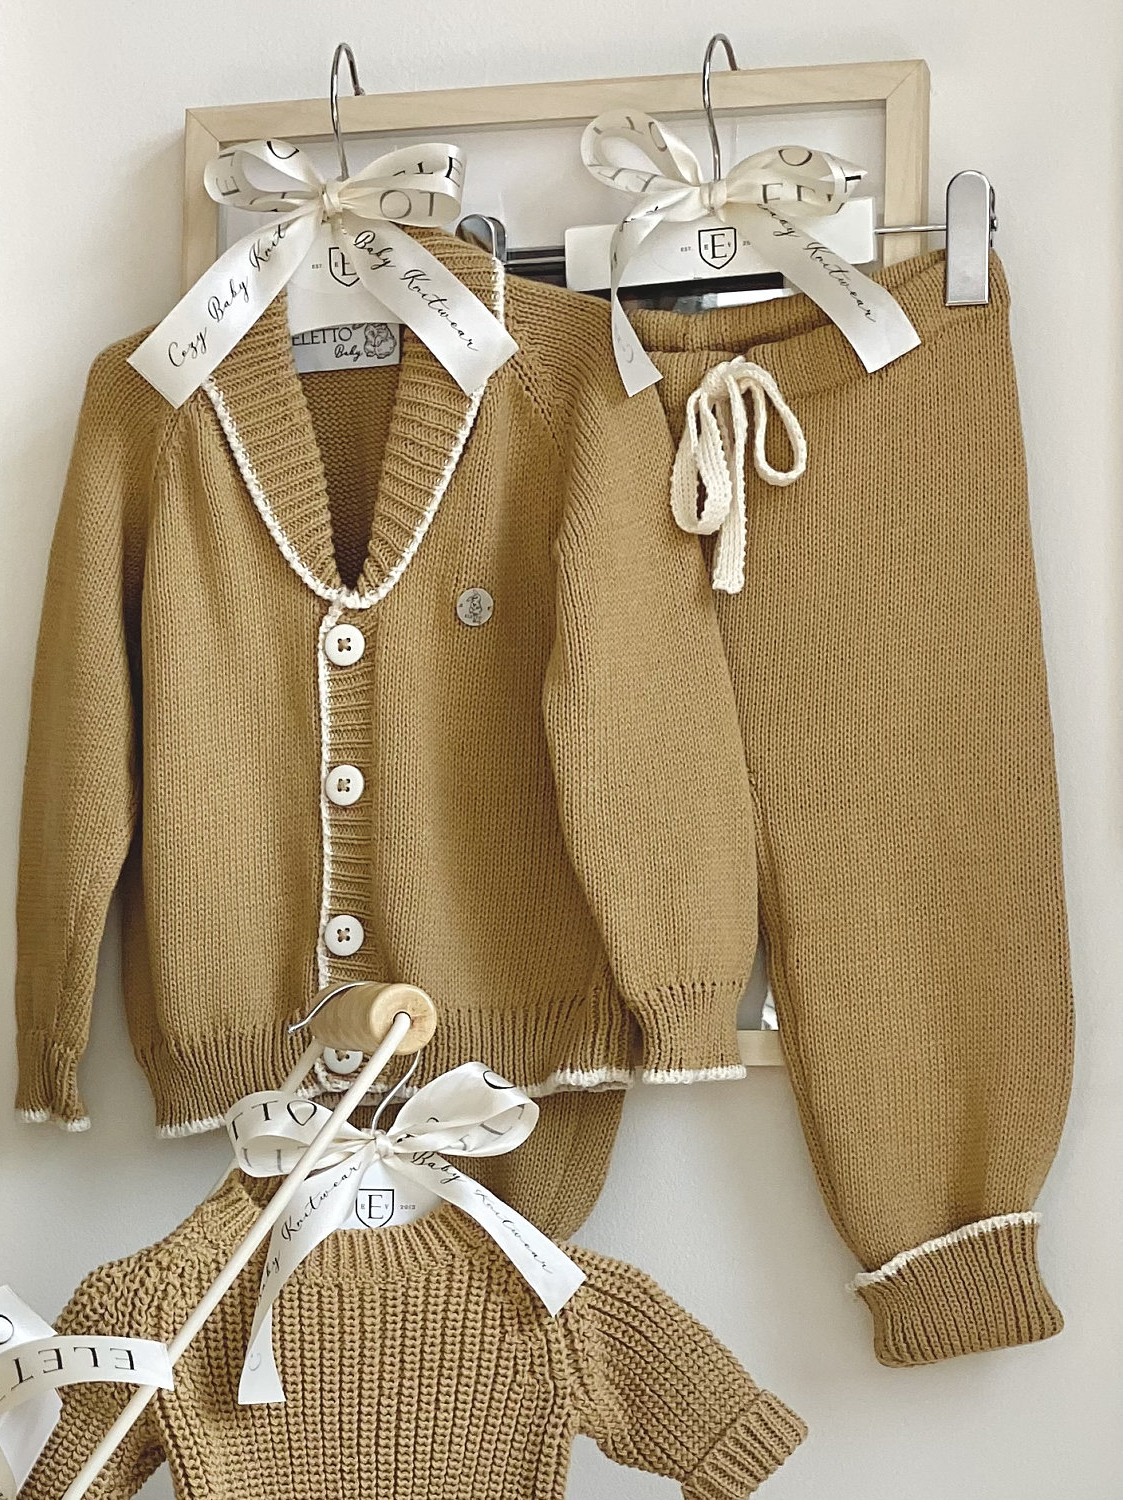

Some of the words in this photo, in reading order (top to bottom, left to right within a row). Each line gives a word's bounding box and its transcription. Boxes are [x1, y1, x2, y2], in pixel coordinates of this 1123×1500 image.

[710, 233, 728, 259] E
[802, 241, 877, 323] Knitwear
[168, 326, 210, 368] Cozy
[207, 275, 251, 322] Baby
[353, 229, 396, 270] Baby
[399, 268, 480, 352] Knitwear
[334, 343, 362, 362] Baby
[280, 1161, 362, 1241] Knitwear
[367, 1194, 384, 1220] E
[413, 1150, 467, 1186] Baby
[473, 1188, 554, 1274] Knitwear
